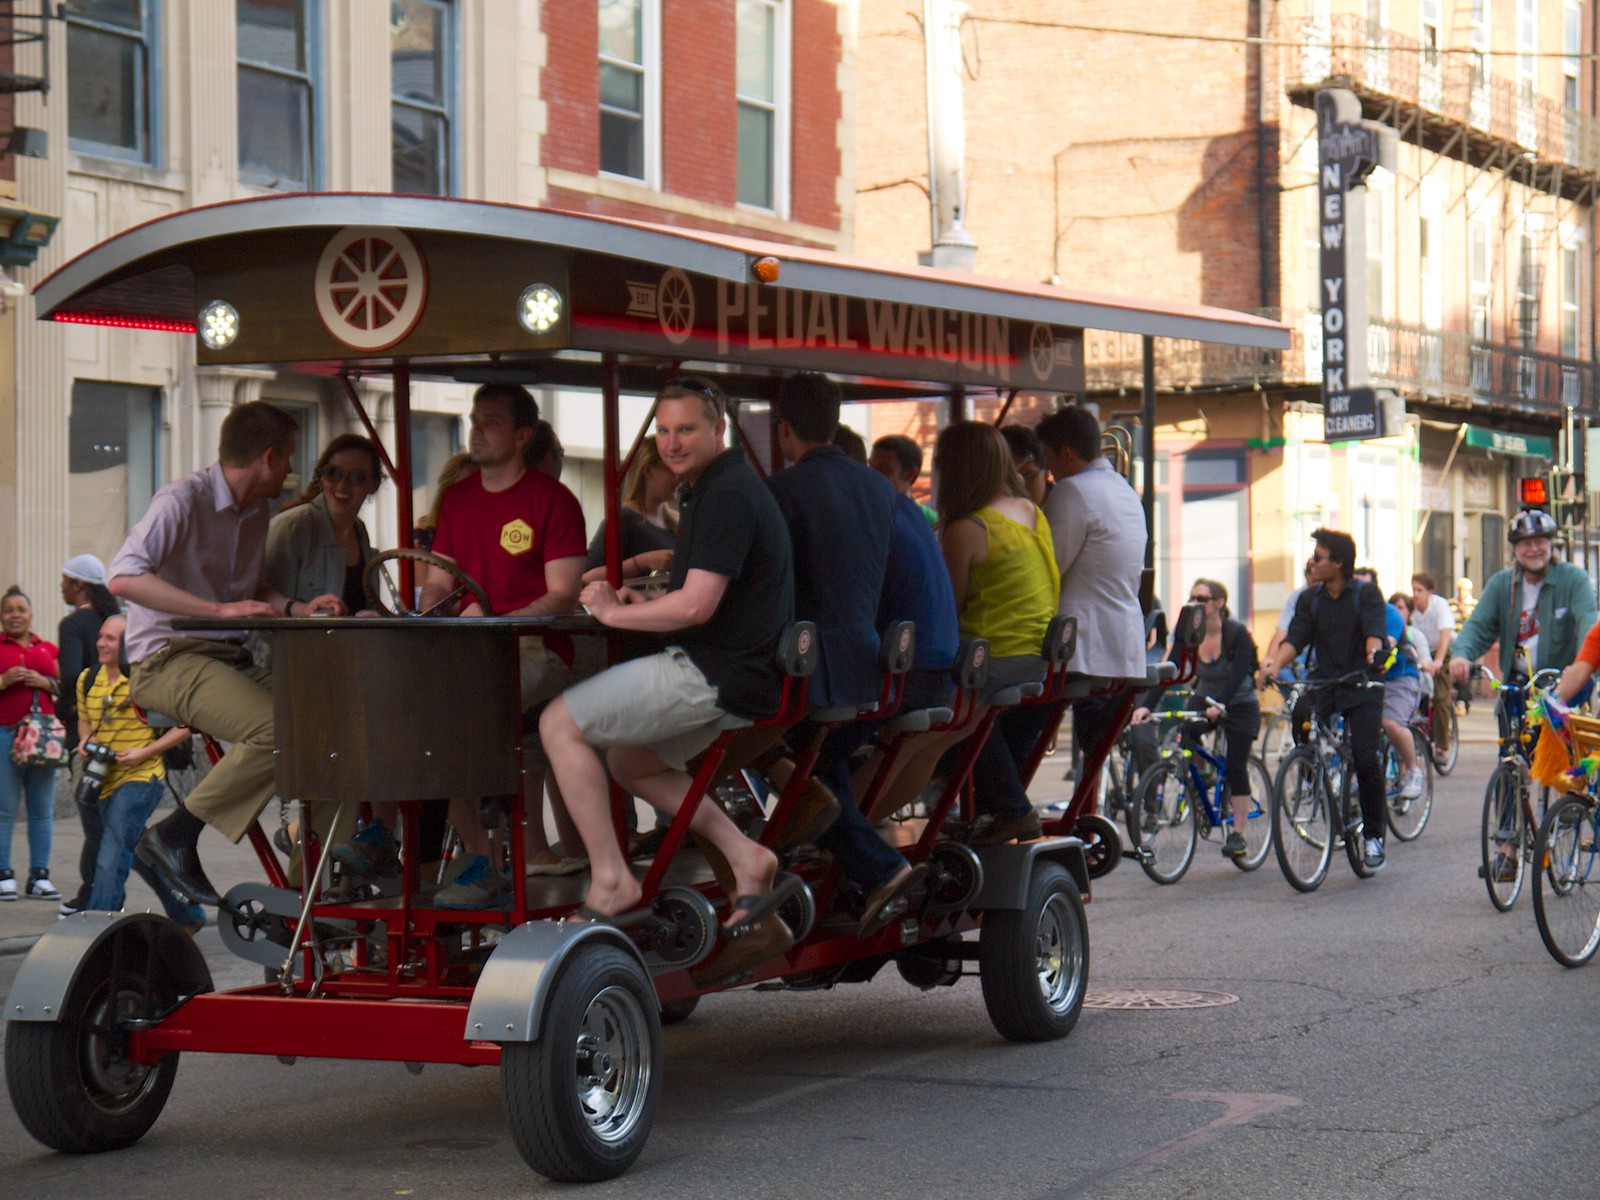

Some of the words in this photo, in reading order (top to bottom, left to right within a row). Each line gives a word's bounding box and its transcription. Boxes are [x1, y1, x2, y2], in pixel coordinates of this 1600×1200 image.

[1323, 163, 1344, 250] NEW
[1325, 277, 1345, 393] YORK
[1325, 413, 1375, 434] CLEANERS
[1330, 395, 1351, 414] DRY
